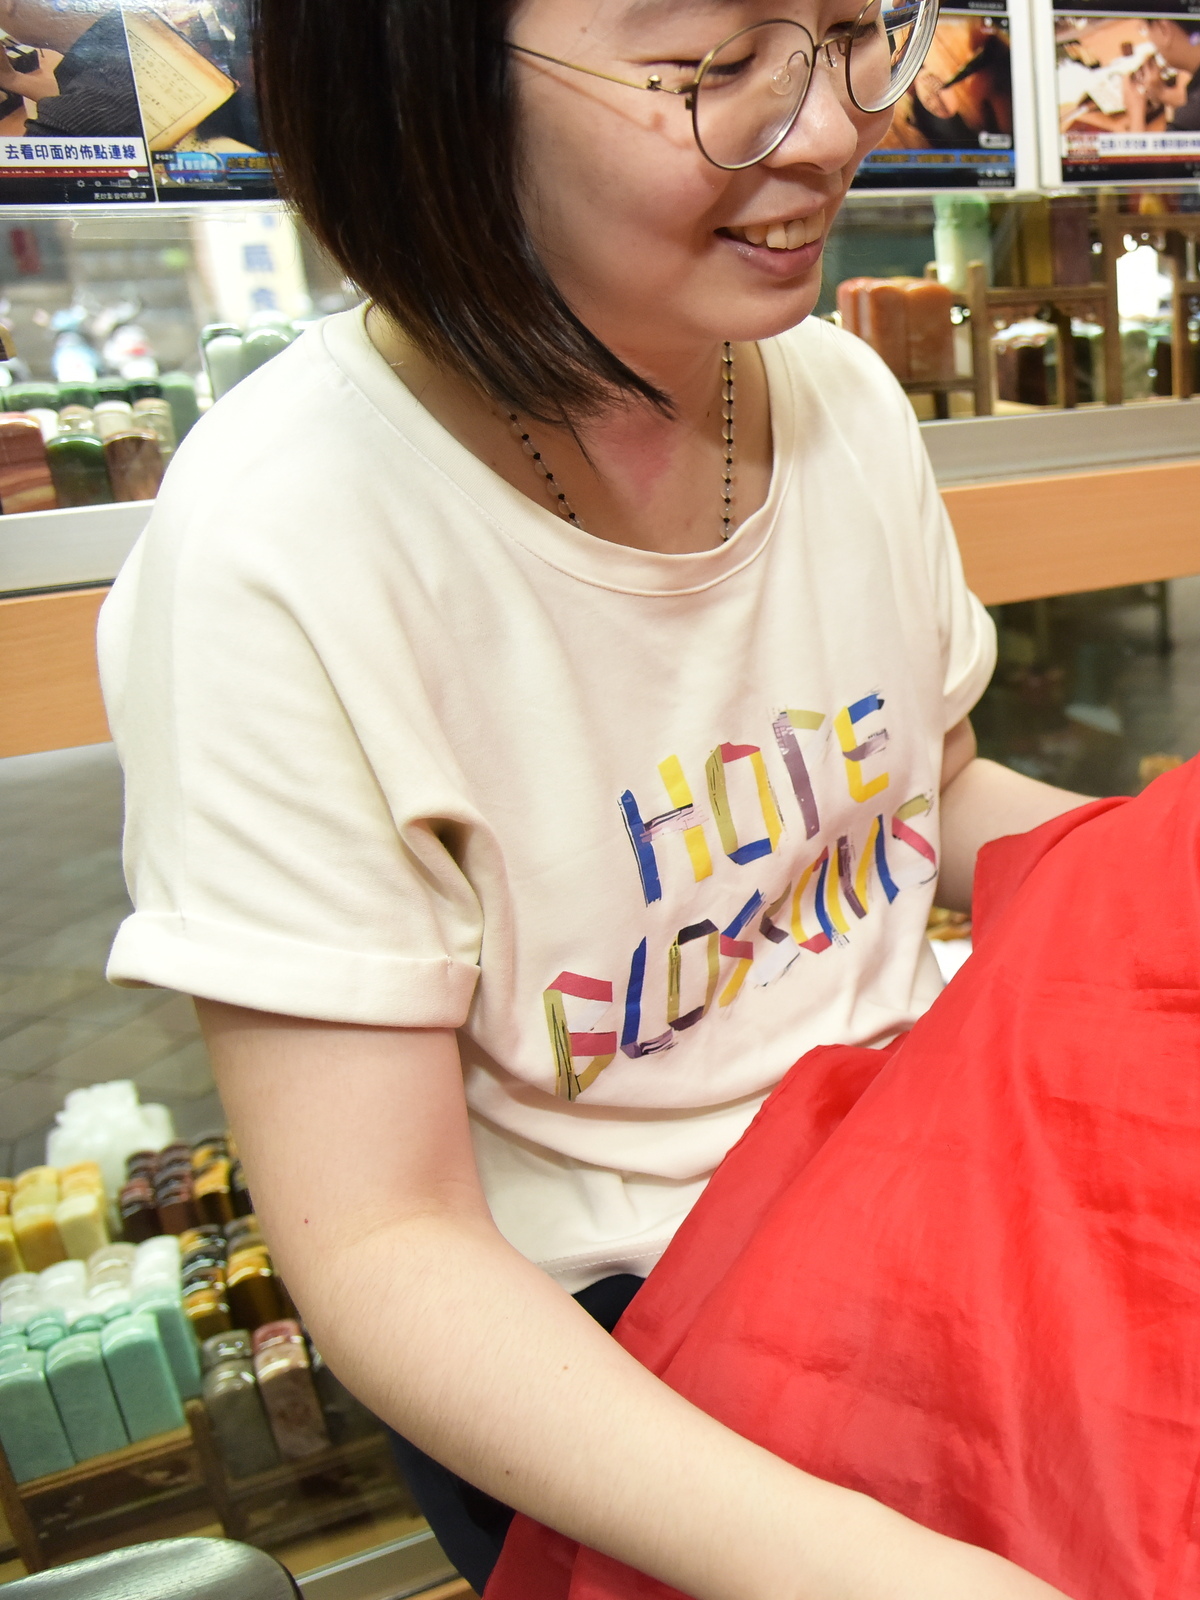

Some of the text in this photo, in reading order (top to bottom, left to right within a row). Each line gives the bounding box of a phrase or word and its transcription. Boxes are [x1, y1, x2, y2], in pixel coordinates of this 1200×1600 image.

[4, 143, 137, 161] 去看印面的佈點連線
[616, 688, 891, 907] HOPE
